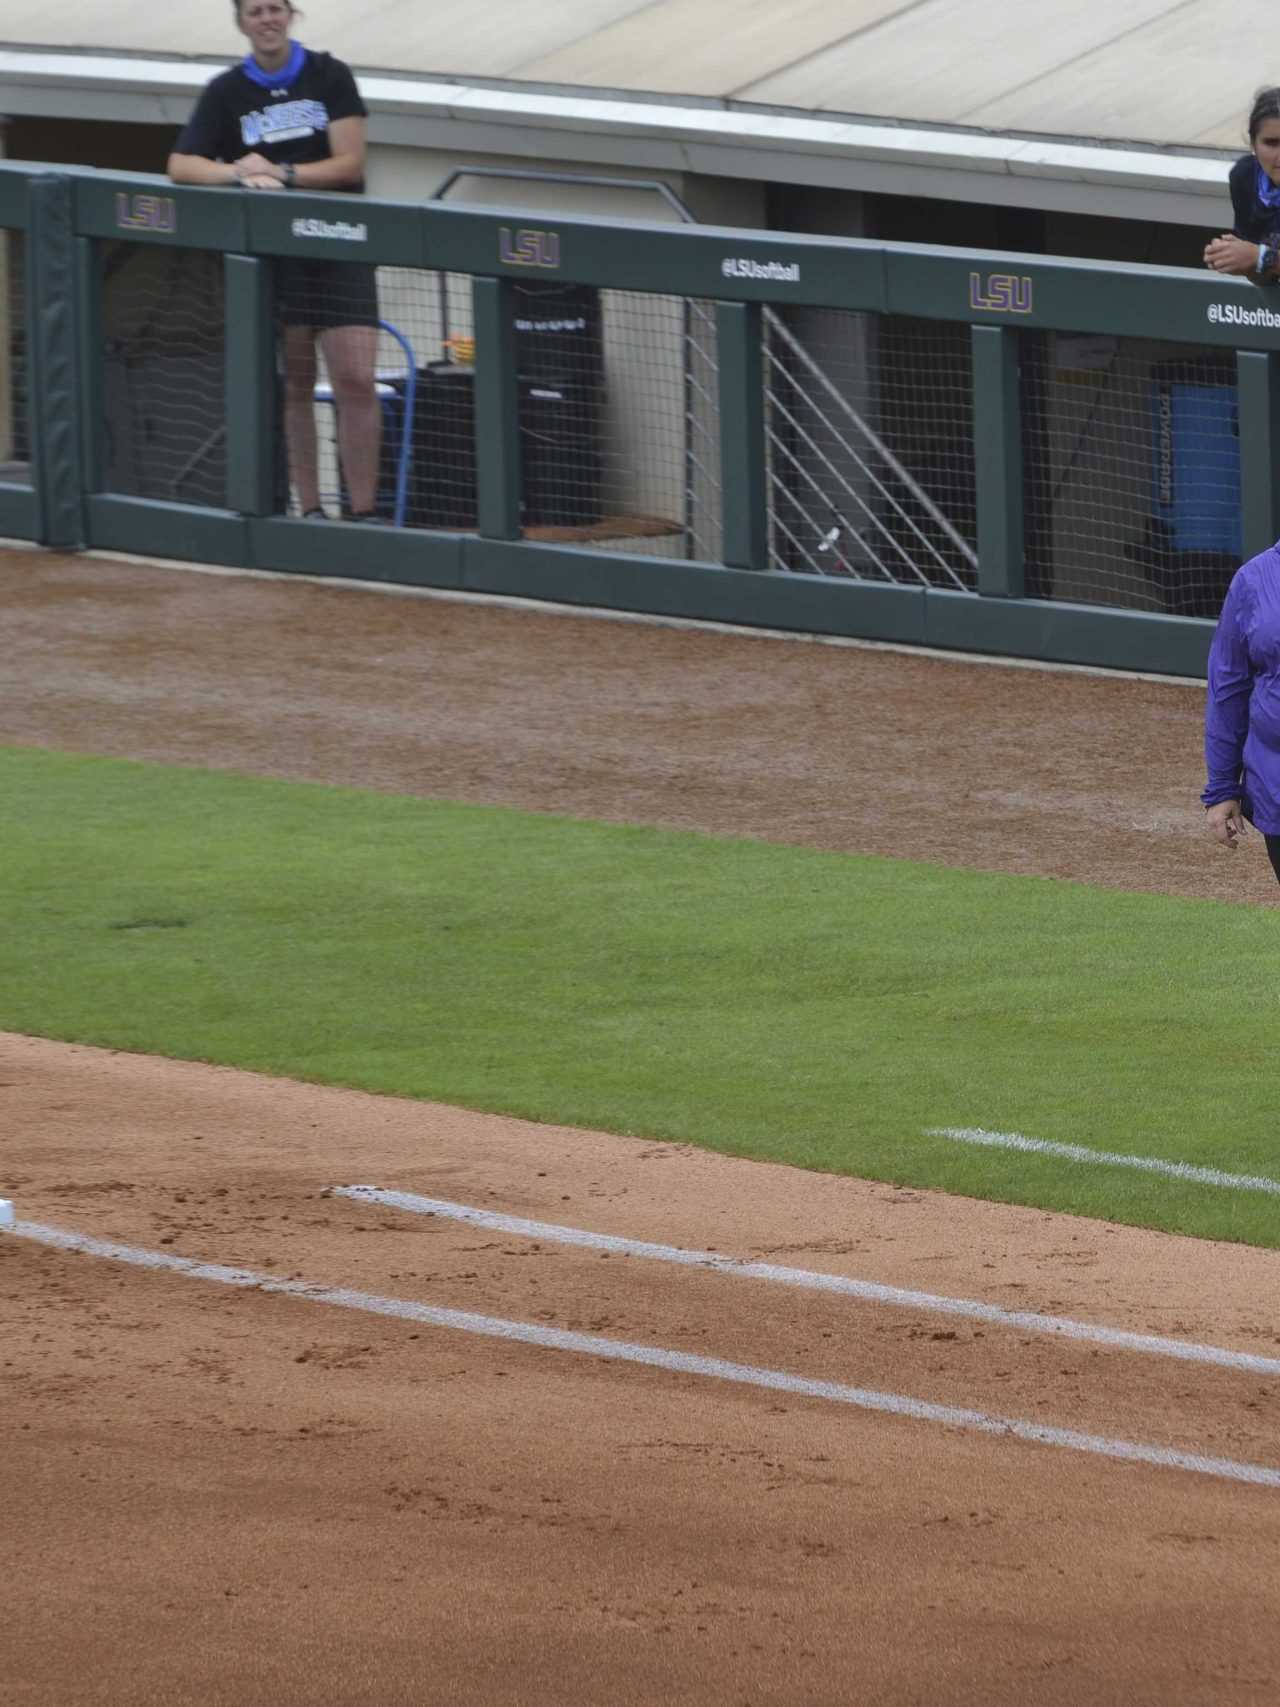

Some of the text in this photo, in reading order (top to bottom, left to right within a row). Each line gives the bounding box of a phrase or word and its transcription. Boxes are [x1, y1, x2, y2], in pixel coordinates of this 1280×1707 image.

[115, 193, 177, 234] LSU
[498, 227, 561, 269] LSU
[721, 258, 800, 281] @LSUsoftball
[969, 272, 1033, 313] LSU
